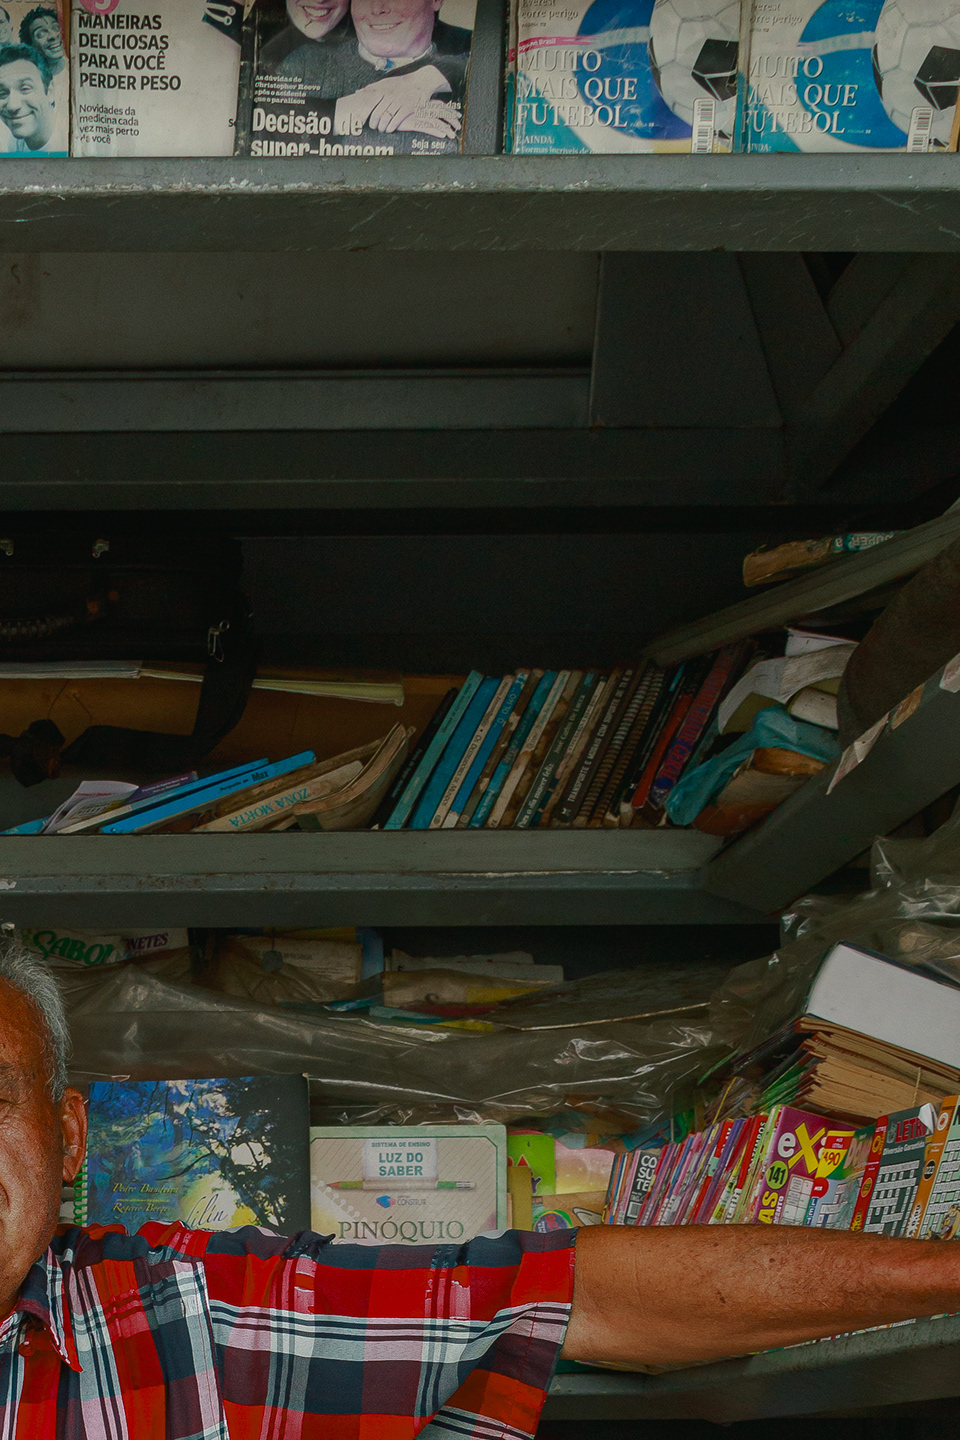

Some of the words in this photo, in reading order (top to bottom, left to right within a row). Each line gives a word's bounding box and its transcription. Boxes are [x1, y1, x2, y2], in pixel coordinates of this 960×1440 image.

[79, 14, 161, 30] MANEIRAS
[79, 33, 168, 50] DELICIOSAS
[79, 53, 119, 70] PARA
[123, 50, 165, 70] VOCÊ
[520, 50, 602, 72] MUITO
[80, 73, 136, 90] PERDER
[141, 75, 181, 90] PESO
[255, 82, 296, 91] Christopher
[518, 78, 578, 99] MAIS
[584, 77, 637, 106] QUE
[80, 104, 123, 116] Novidades
[125, 107, 135, 116] da
[80, 114, 117, 124] medicina
[118, 118, 138, 126] cada
[516, 103, 627, 128] FUTEBOL
[253, 108, 331, 135] Decisão
[341, 118, 362, 136] de
[741, 110, 845, 134] FUTEBOL
[276, 788, 311, 809] ZONA
[228, 804, 275, 828] MORTA
[379, 1152, 402, 1163] LUZ
[407, 1152, 423, 1163] DO
[379, 1165, 423, 1176] SABER
[338, 1216, 464, 1243] PINÓQUIO
